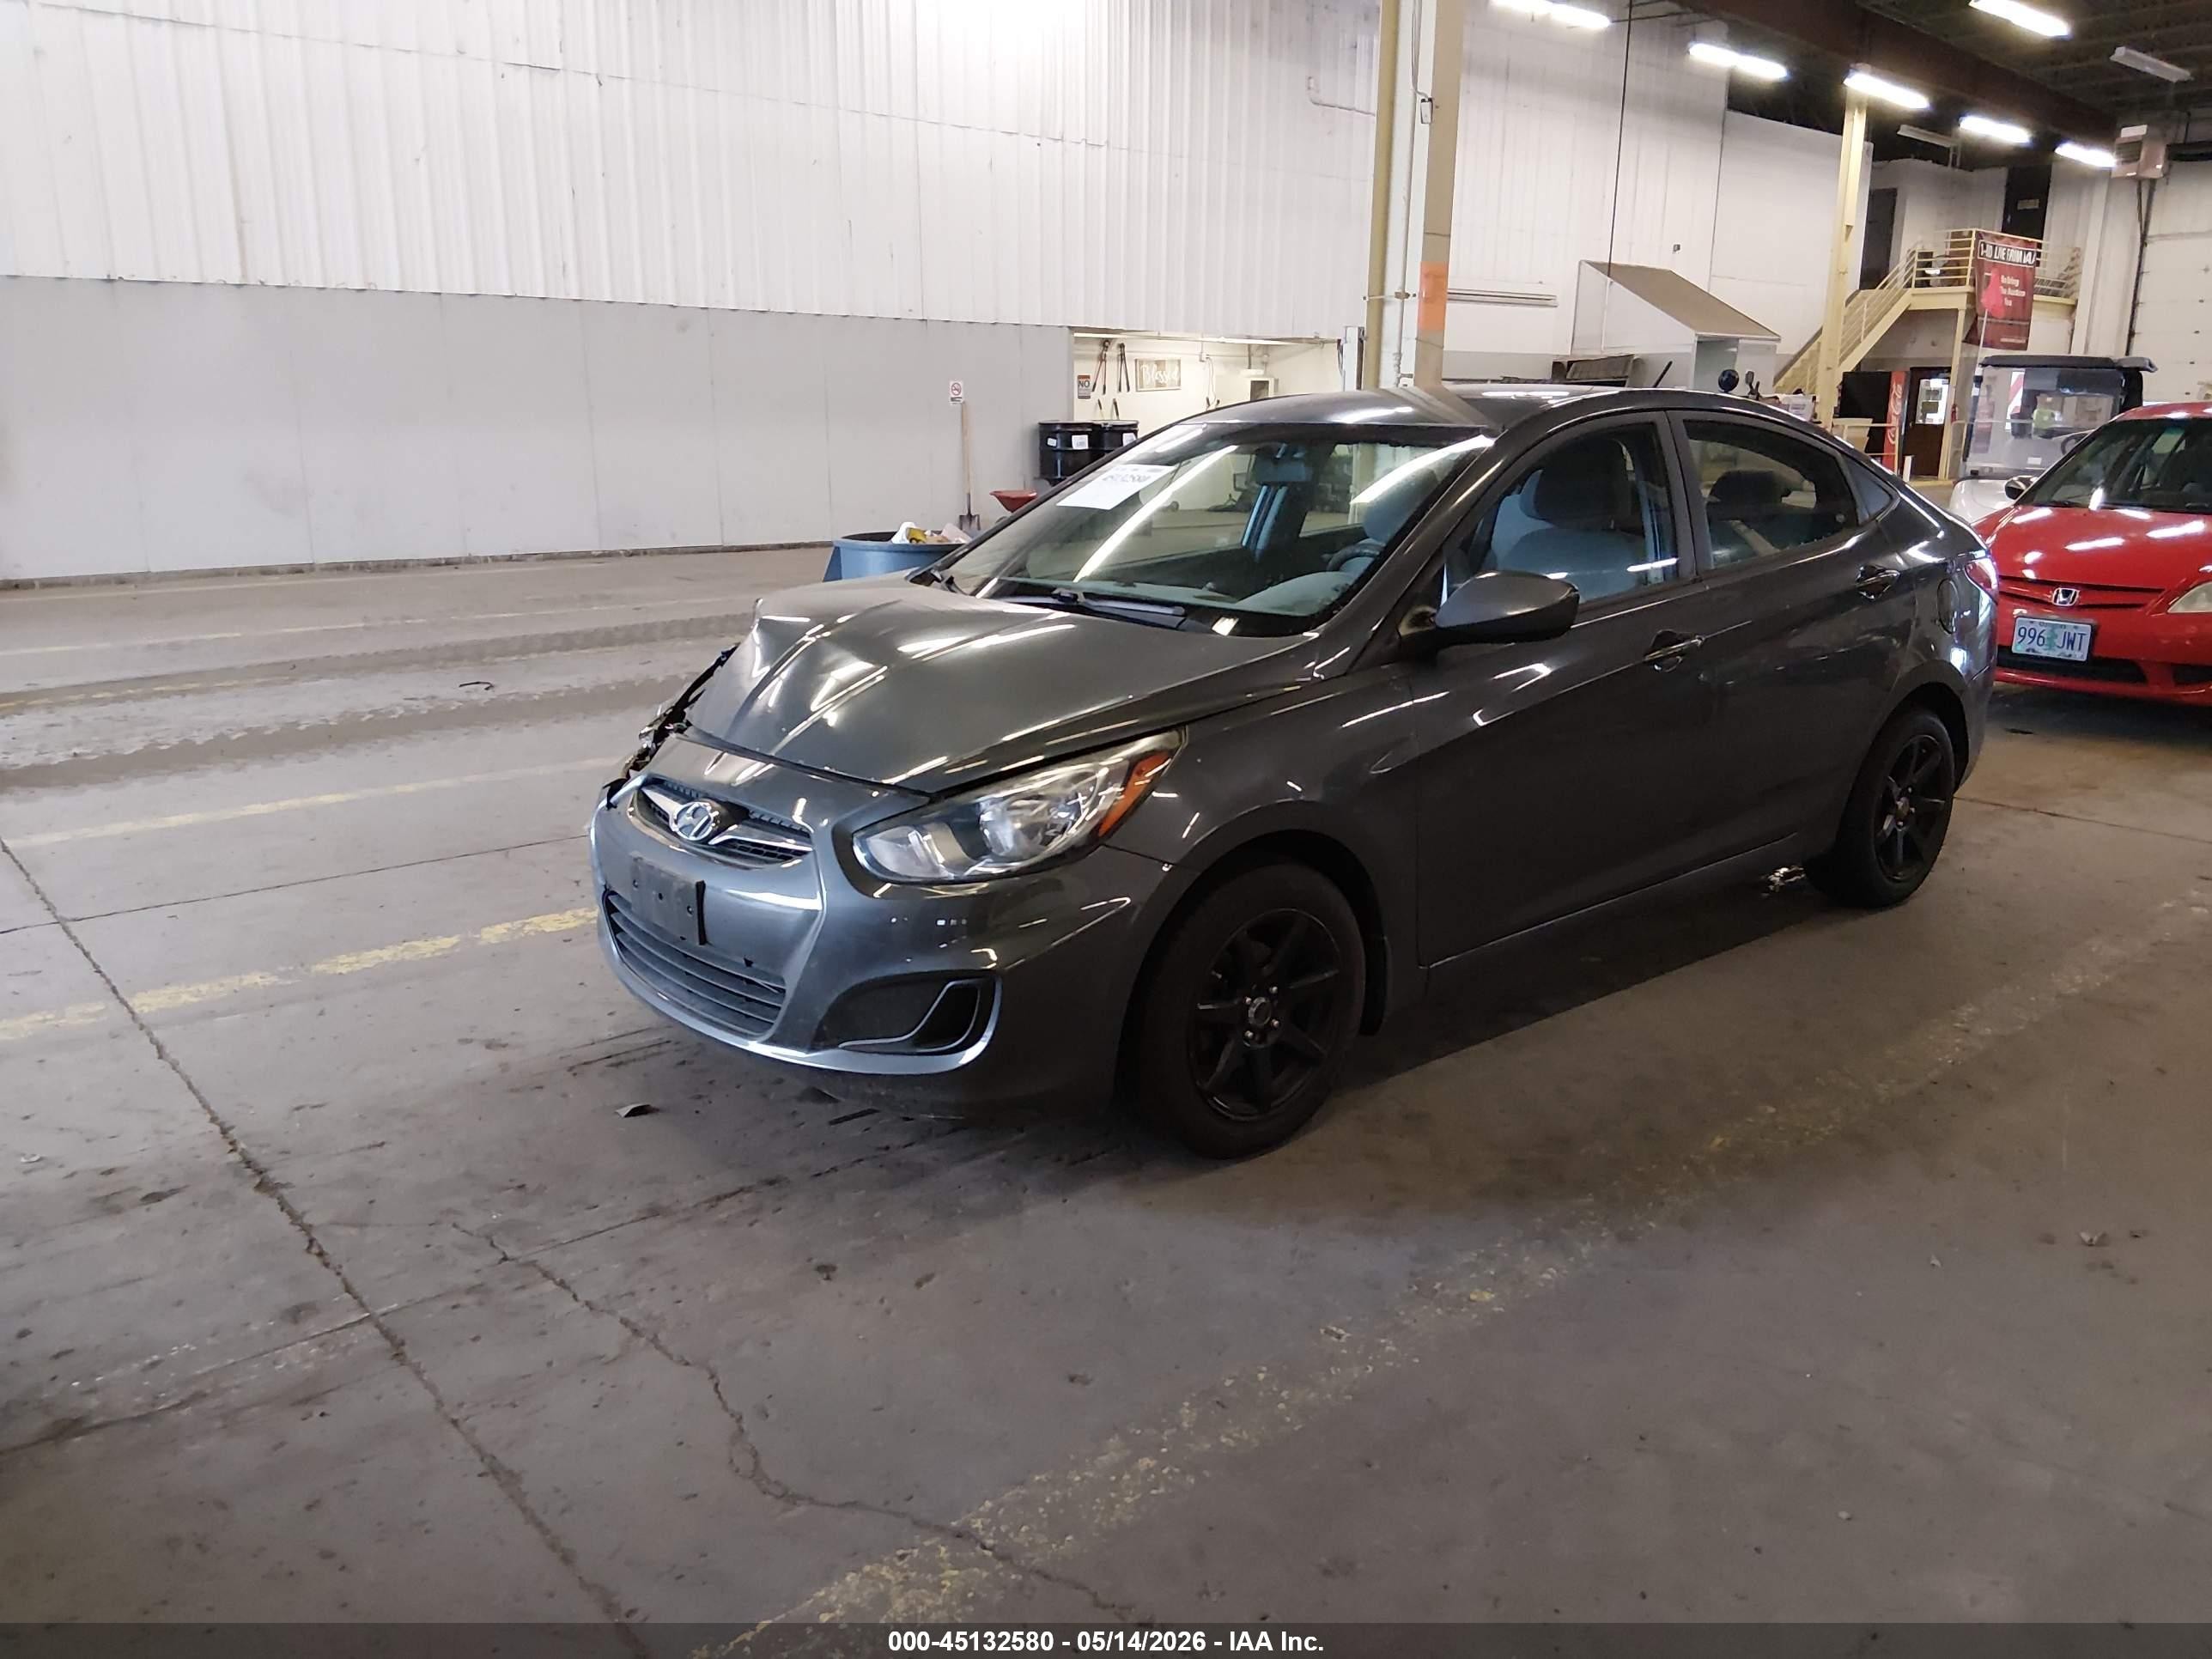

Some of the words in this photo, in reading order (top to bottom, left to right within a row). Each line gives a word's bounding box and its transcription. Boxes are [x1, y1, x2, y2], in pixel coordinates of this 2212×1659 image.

[1078, 380, 1091, 388] NO
[2018, 626, 2046, 647] 996
[2057, 631, 2087, 651] JWT
